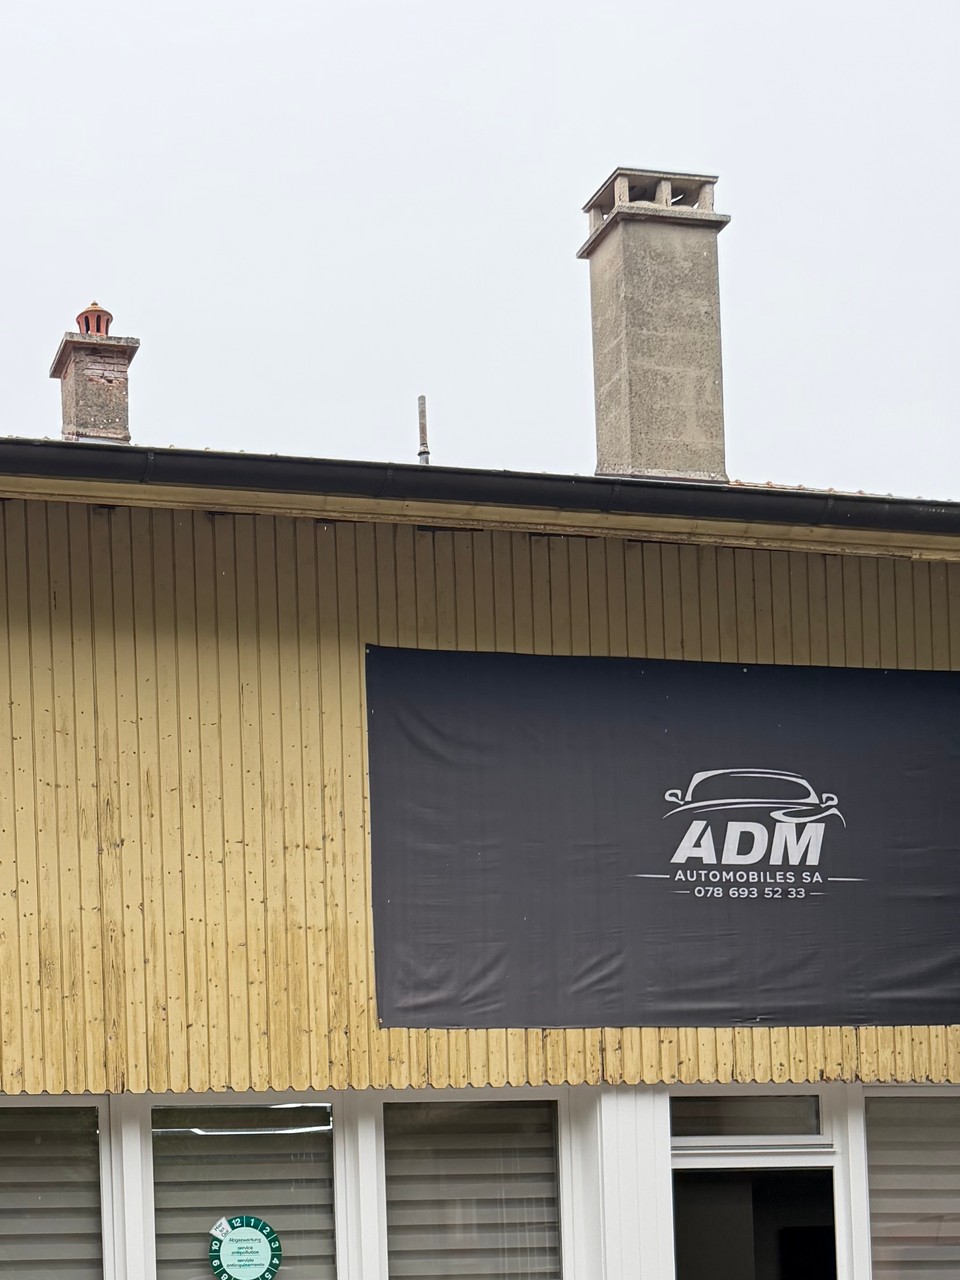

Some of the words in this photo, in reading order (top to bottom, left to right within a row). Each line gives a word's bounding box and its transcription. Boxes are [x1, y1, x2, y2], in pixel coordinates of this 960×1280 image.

[669, 820, 826, 866] ADM
[674, 870, 795, 883] AUTOMOBILES
[802, 872, 823, 883] SA
[694, 886, 723, 898] 078
[729, 887, 758, 899] 693
[763, 887, 782, 899] 52
[787, 888, 806, 899] 33
[231, 1218, 242, 1227] 12
[250, 1218, 255, 1227] 1
[262, 1226, 271, 1235] 2
[211, 1240, 220, 1251] 10
[272, 1257, 280, 1265] 4
[220, 1273, 229, 1280] 8
[264, 1272, 273, 1280] 5
